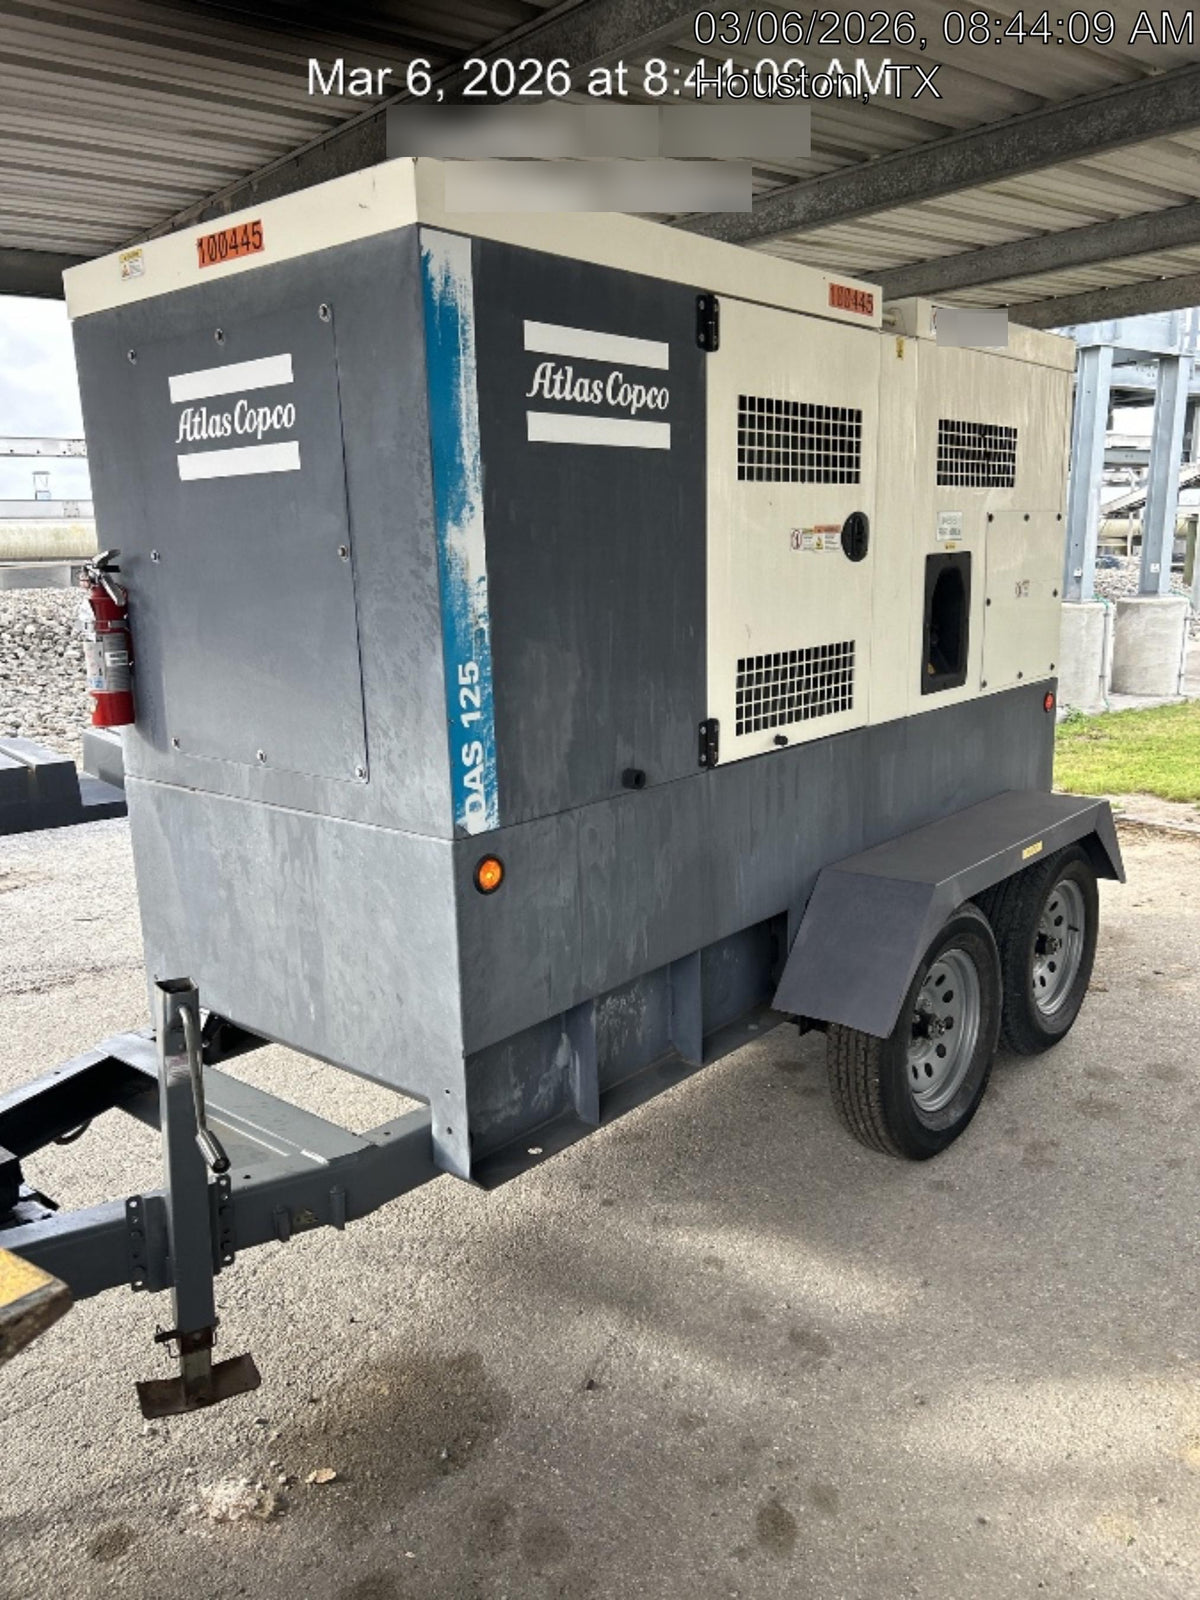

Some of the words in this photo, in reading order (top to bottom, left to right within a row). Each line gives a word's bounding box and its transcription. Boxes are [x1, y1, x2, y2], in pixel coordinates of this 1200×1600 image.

[197, 221, 263, 264] 100445
[525, 362, 603, 404] Atlas
[606, 371, 669, 415] Copco
[175, 407, 231, 443] Atlas
[234, 399, 296, 440] Copco
[458, 660, 483, 728] 125
[461, 740, 487, 834] DAS
